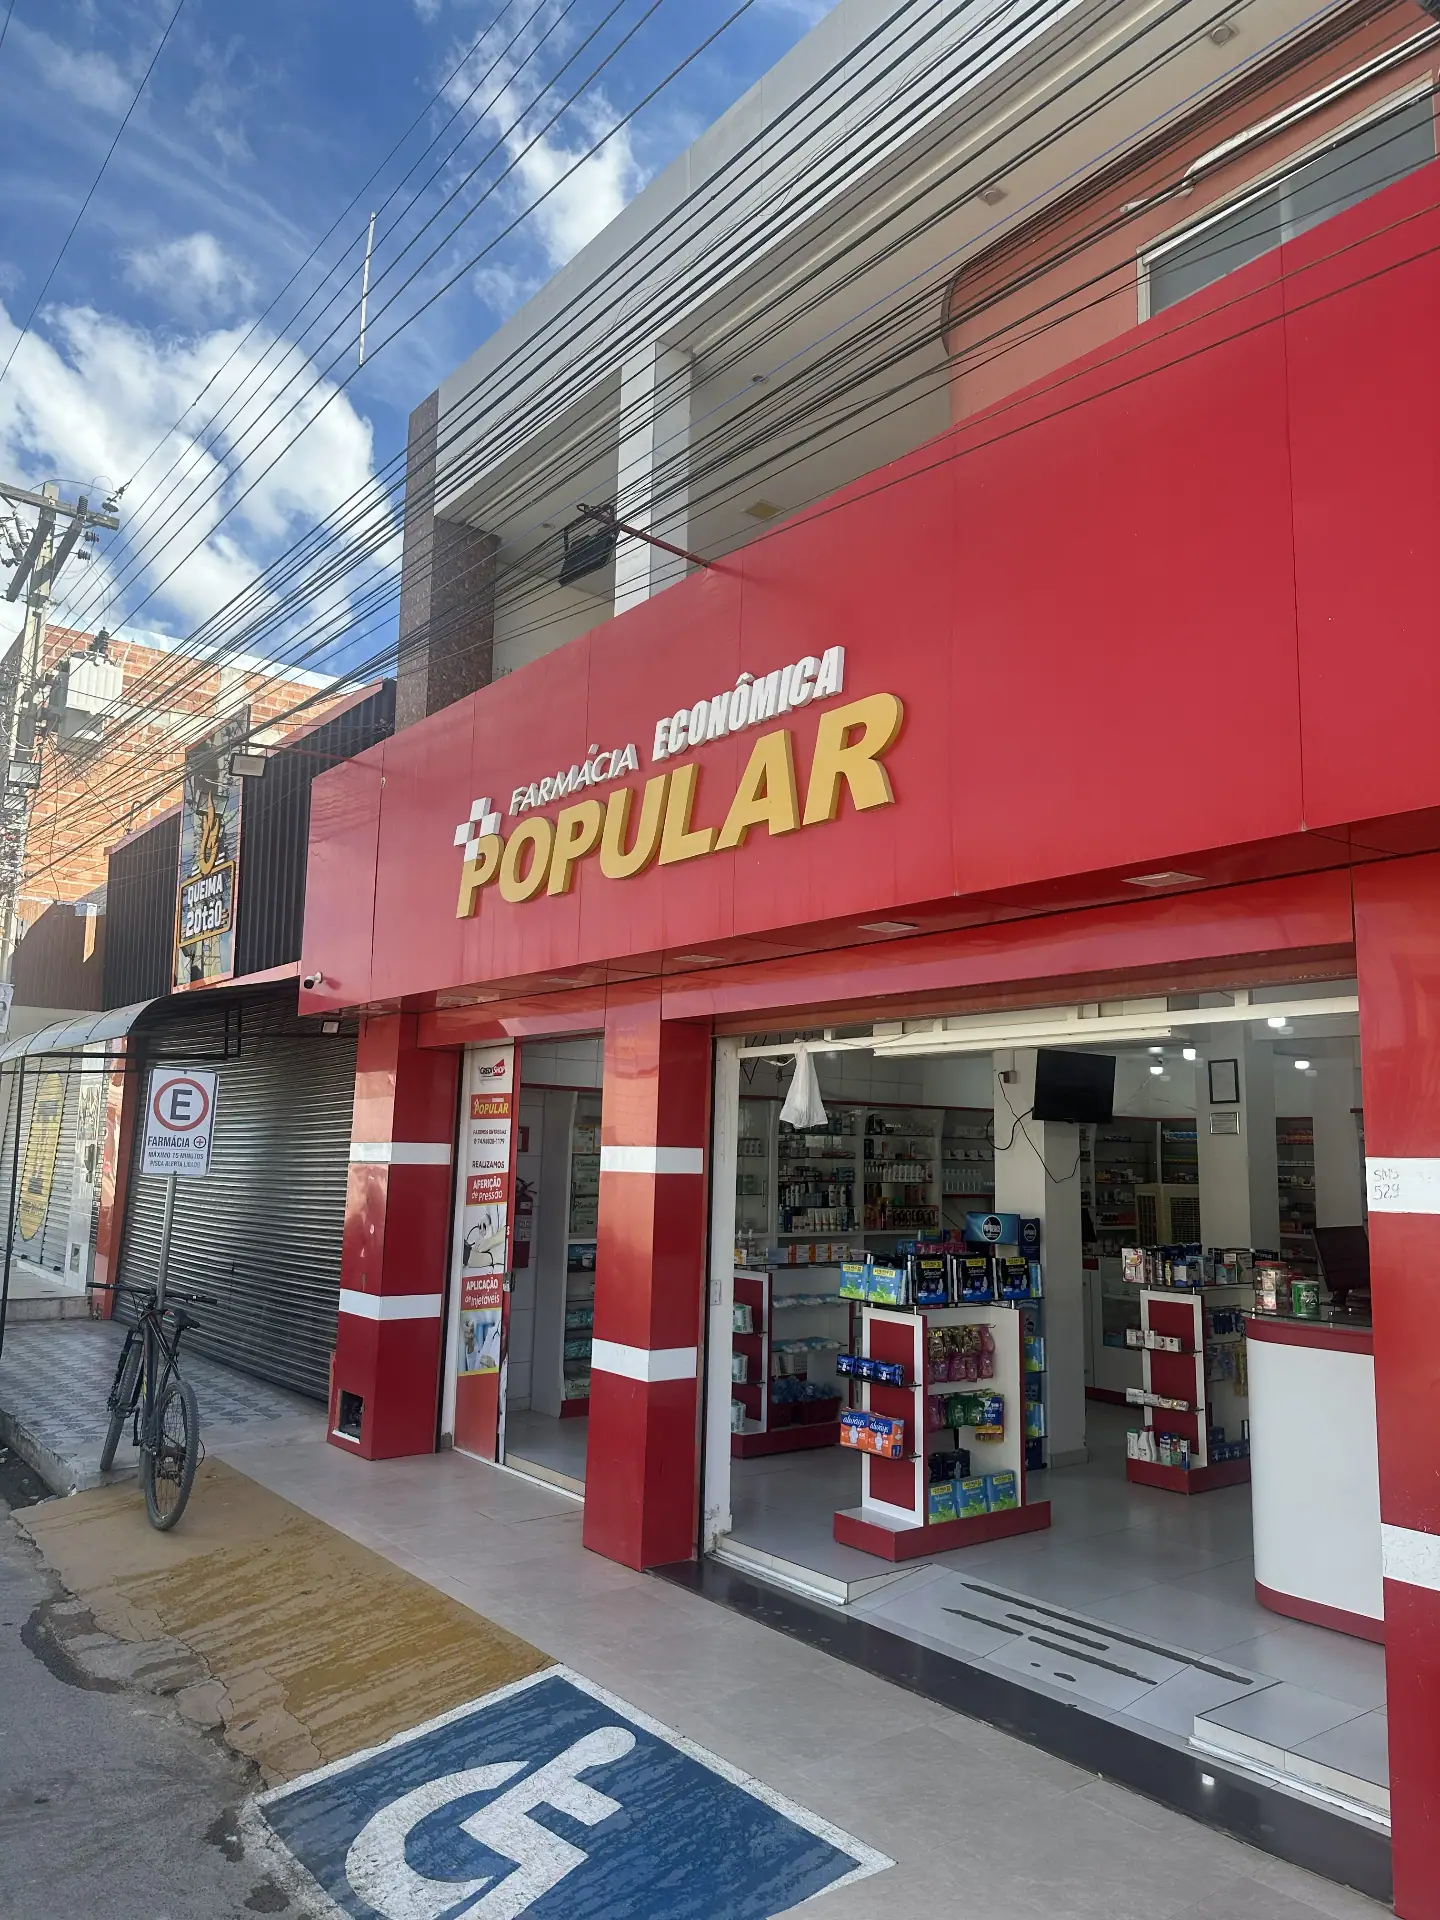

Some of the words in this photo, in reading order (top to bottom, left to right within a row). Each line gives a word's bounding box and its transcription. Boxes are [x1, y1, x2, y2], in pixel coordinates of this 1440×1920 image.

[508, 743, 640, 816] FARMÁCIA
[651, 645, 846, 762] ECONÔMICA
[455, 692, 904, 919] POPULAR
[187, 873, 223, 908] QUEIMA
[170, 1088, 193, 1121] E
[474, 1102, 509, 1115] POPULAR
[147, 1134, 190, 1148] FARMÁCIA
[148, 1151, 171, 1159] MÁXIMO
[180, 1152, 204, 1160] MINUTOS
[165, 1160, 182, 1168] ALERTA
[472, 1160, 505, 1169] REALIZAMOS
[473, 1176, 502, 1191] AFERIÇÃO
[466, 1276, 499, 1293] APLICAÇÃO
[842, 1415, 866, 1428] always
[869, 1421, 890, 1434] always
